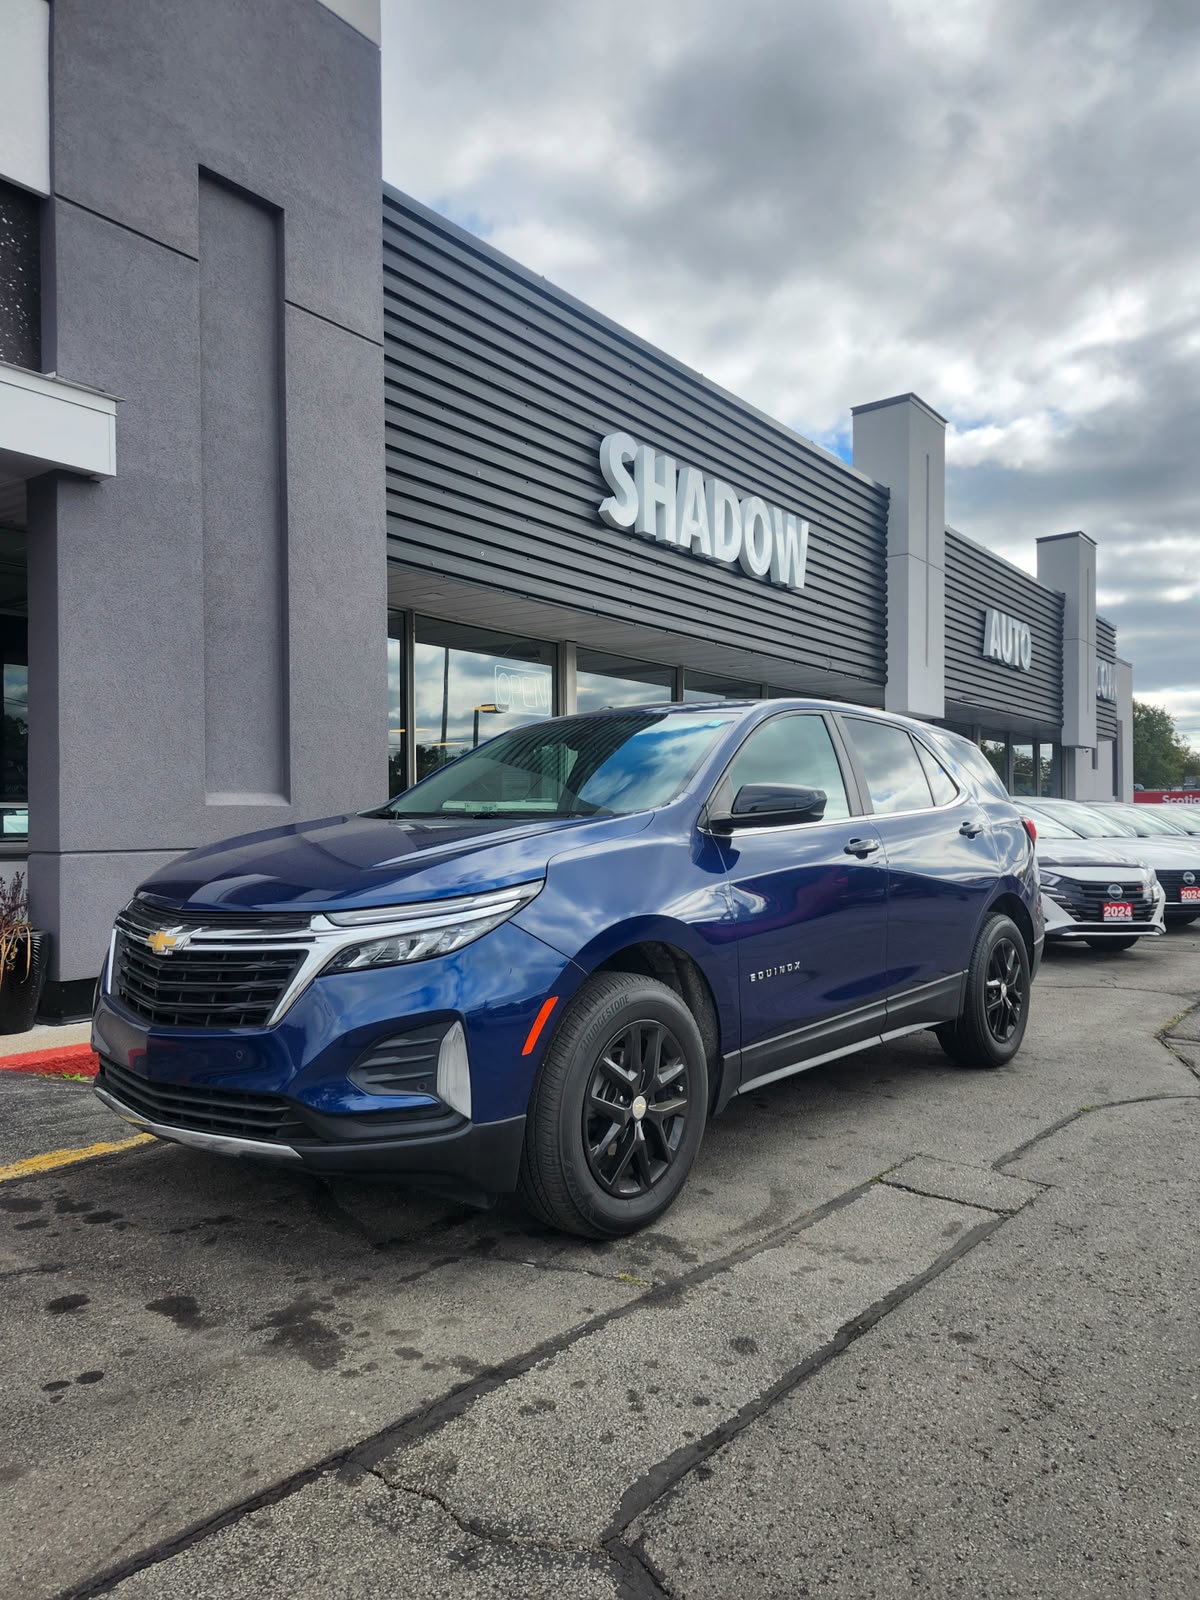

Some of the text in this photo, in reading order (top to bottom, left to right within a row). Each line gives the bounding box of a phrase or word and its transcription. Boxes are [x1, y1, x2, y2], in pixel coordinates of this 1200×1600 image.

[598, 431, 809, 589] SHADOW
[983, 608, 1031, 670] AUTO
[498, 672, 548, 707] OPEN
[1104, 906, 1132, 917] 2024
[750, 961, 800, 982] EQUINOX
